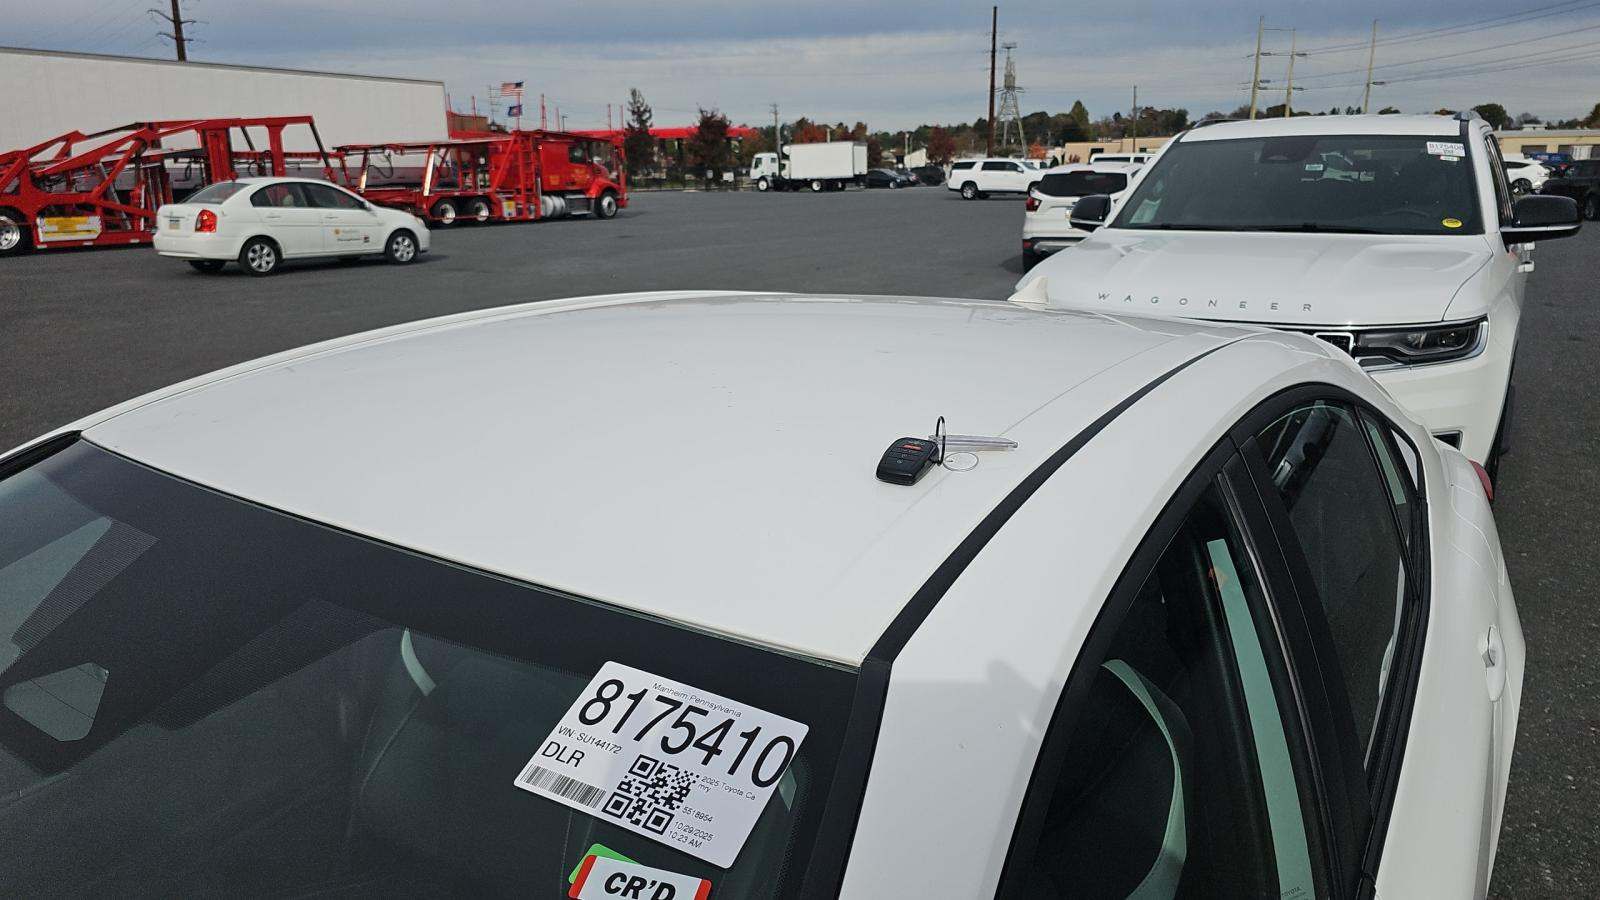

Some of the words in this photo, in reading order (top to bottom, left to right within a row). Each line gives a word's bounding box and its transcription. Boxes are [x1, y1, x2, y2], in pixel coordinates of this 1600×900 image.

[1098, 292, 1312, 312] WAGONEER
[652, 682, 688, 700] Manheim
[689, 694, 742, 718] Pennsylvania
[558, 725, 577, 739] VIN:
[576, 732, 622, 755] SU144172
[578, 679, 795, 788] 8175410
[541, 741, 585, 768] DLR
[701, 776, 720, 787] 2025
[720, 782, 744, 796] Toyota
[745, 791, 756, 801] Ca
[681, 806, 713, 823] 5518954
[673, 821, 714, 842] 10/29/2025
[687, 838, 703, 849] AM
